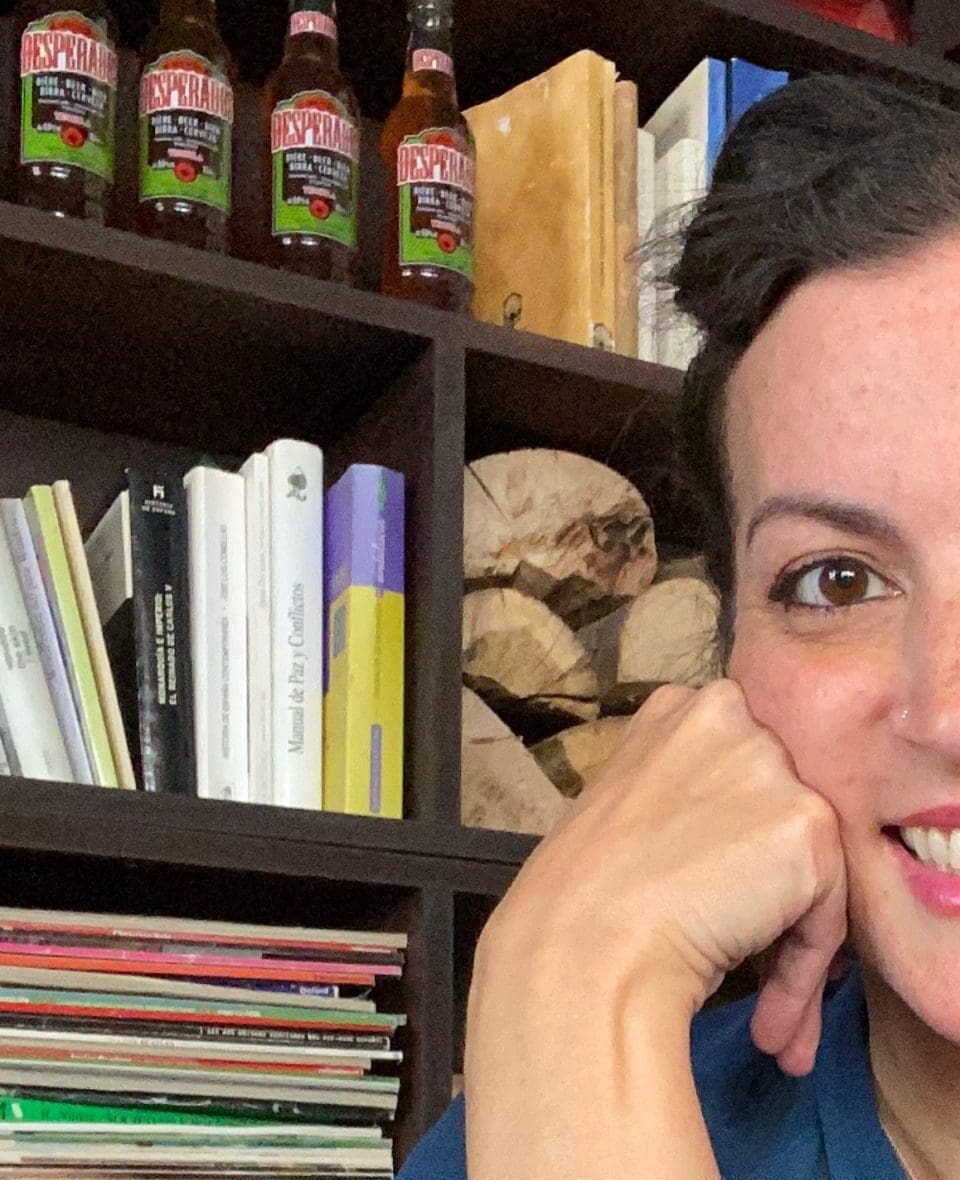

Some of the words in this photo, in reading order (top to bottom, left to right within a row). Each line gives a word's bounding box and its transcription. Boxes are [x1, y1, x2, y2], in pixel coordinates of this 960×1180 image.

[165, 593, 174, 631] CARLOS
[287, 582, 305, 648] Conflictos
[166, 633, 175, 647] DE
[292, 652, 309, 661] y
[287, 660, 305, 684] Paz
[169, 694, 178, 705] EL
[287, 687, 305, 704] de
[287, 707, 305, 755] Manual
